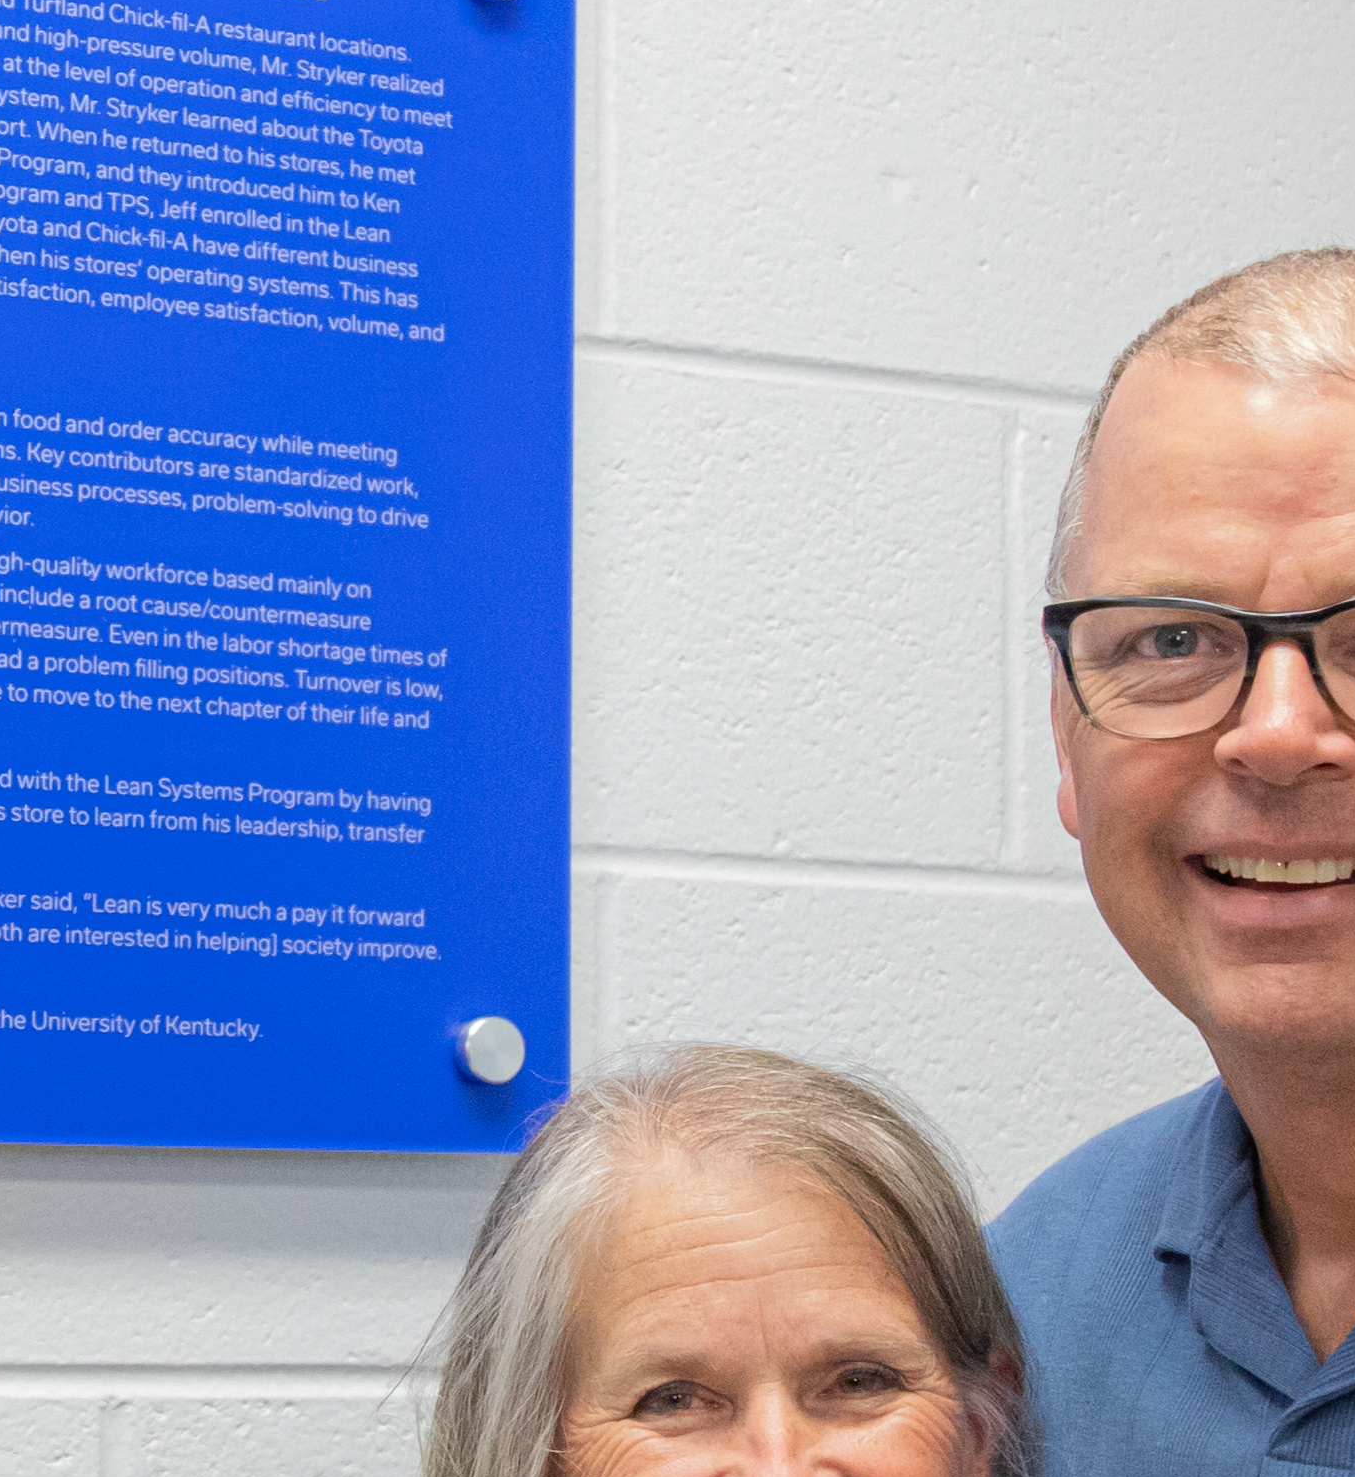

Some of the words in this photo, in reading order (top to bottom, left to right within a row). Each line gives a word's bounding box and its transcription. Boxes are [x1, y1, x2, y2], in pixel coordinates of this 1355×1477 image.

[34, 23, 176, 62] high-pressure
[178, 46, 258, 76] volume,
[261, 54, 292, 77] Mr.
[296, 58, 367, 87] Stryker
[369, 72, 446, 98] realized
[107, 2, 212, 35] Chick-fil-A
[214, 21, 317, 50] restaurant
[319, 30, 412, 63] locations.
[95, 162, 135, 183] and
[137, 164, 184, 192] they
[186, 169, 296, 202] introduced
[298, 183, 336, 207] him
[338, 189, 360, 210] to
[362, 190, 401, 215] Ken
[41, 219, 83, 241] and
[85, 220, 190, 252] Chick-fil-A
[191, 233, 241, 259] have
[242, 239, 330, 268] different
[332, 249, 420, 279] business
[12, 407, 62, 433] food
[64, 416, 105, 437] and
[107, 419, 164, 442] order
[166, 426, 259, 455] accuracy
[260, 432, 315, 456] while
[316, 440, 399, 469] meeting
[26, 441, 66, 469] Key
[68, 450, 196, 477] contributors
[197, 461, 231, 481] are
[233, 463, 363, 492] standardized
[366, 476, 420, 500] work,
[78, 593, 92, 611] a
[94, 594, 139, 614] root
[140, 598, 373, 632] cause/countermeasure
[9, 803, 66, 825] store
[68, 806, 91, 826] to
[93, 805, 146, 829] learn
[148, 808, 198, 832] from
[201, 812, 232, 835] his
[234, 813, 345, 844] leadership,
[346, 821, 427, 845] transfer
[30, 1009, 137, 1039] University
[138, 1013, 162, 1035] of
[164, 1014, 264, 1043] Kentucky.
